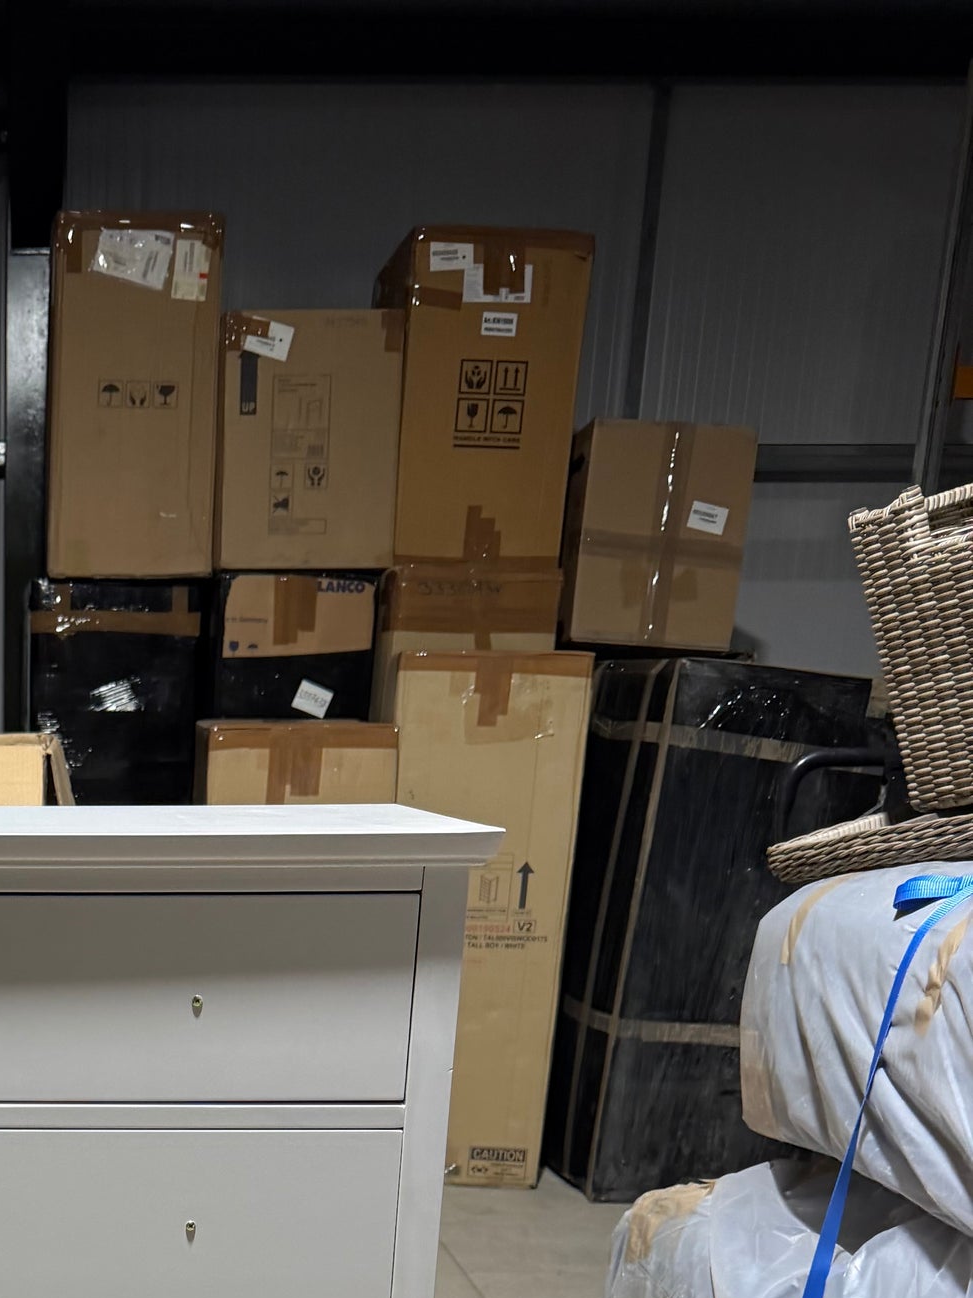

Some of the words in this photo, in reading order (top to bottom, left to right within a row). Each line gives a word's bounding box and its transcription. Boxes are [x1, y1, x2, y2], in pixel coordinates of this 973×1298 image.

[241, 402, 256, 413] UP
[517, 922, 533, 932] V2
[473, 1149, 524, 1162] CAUTION
